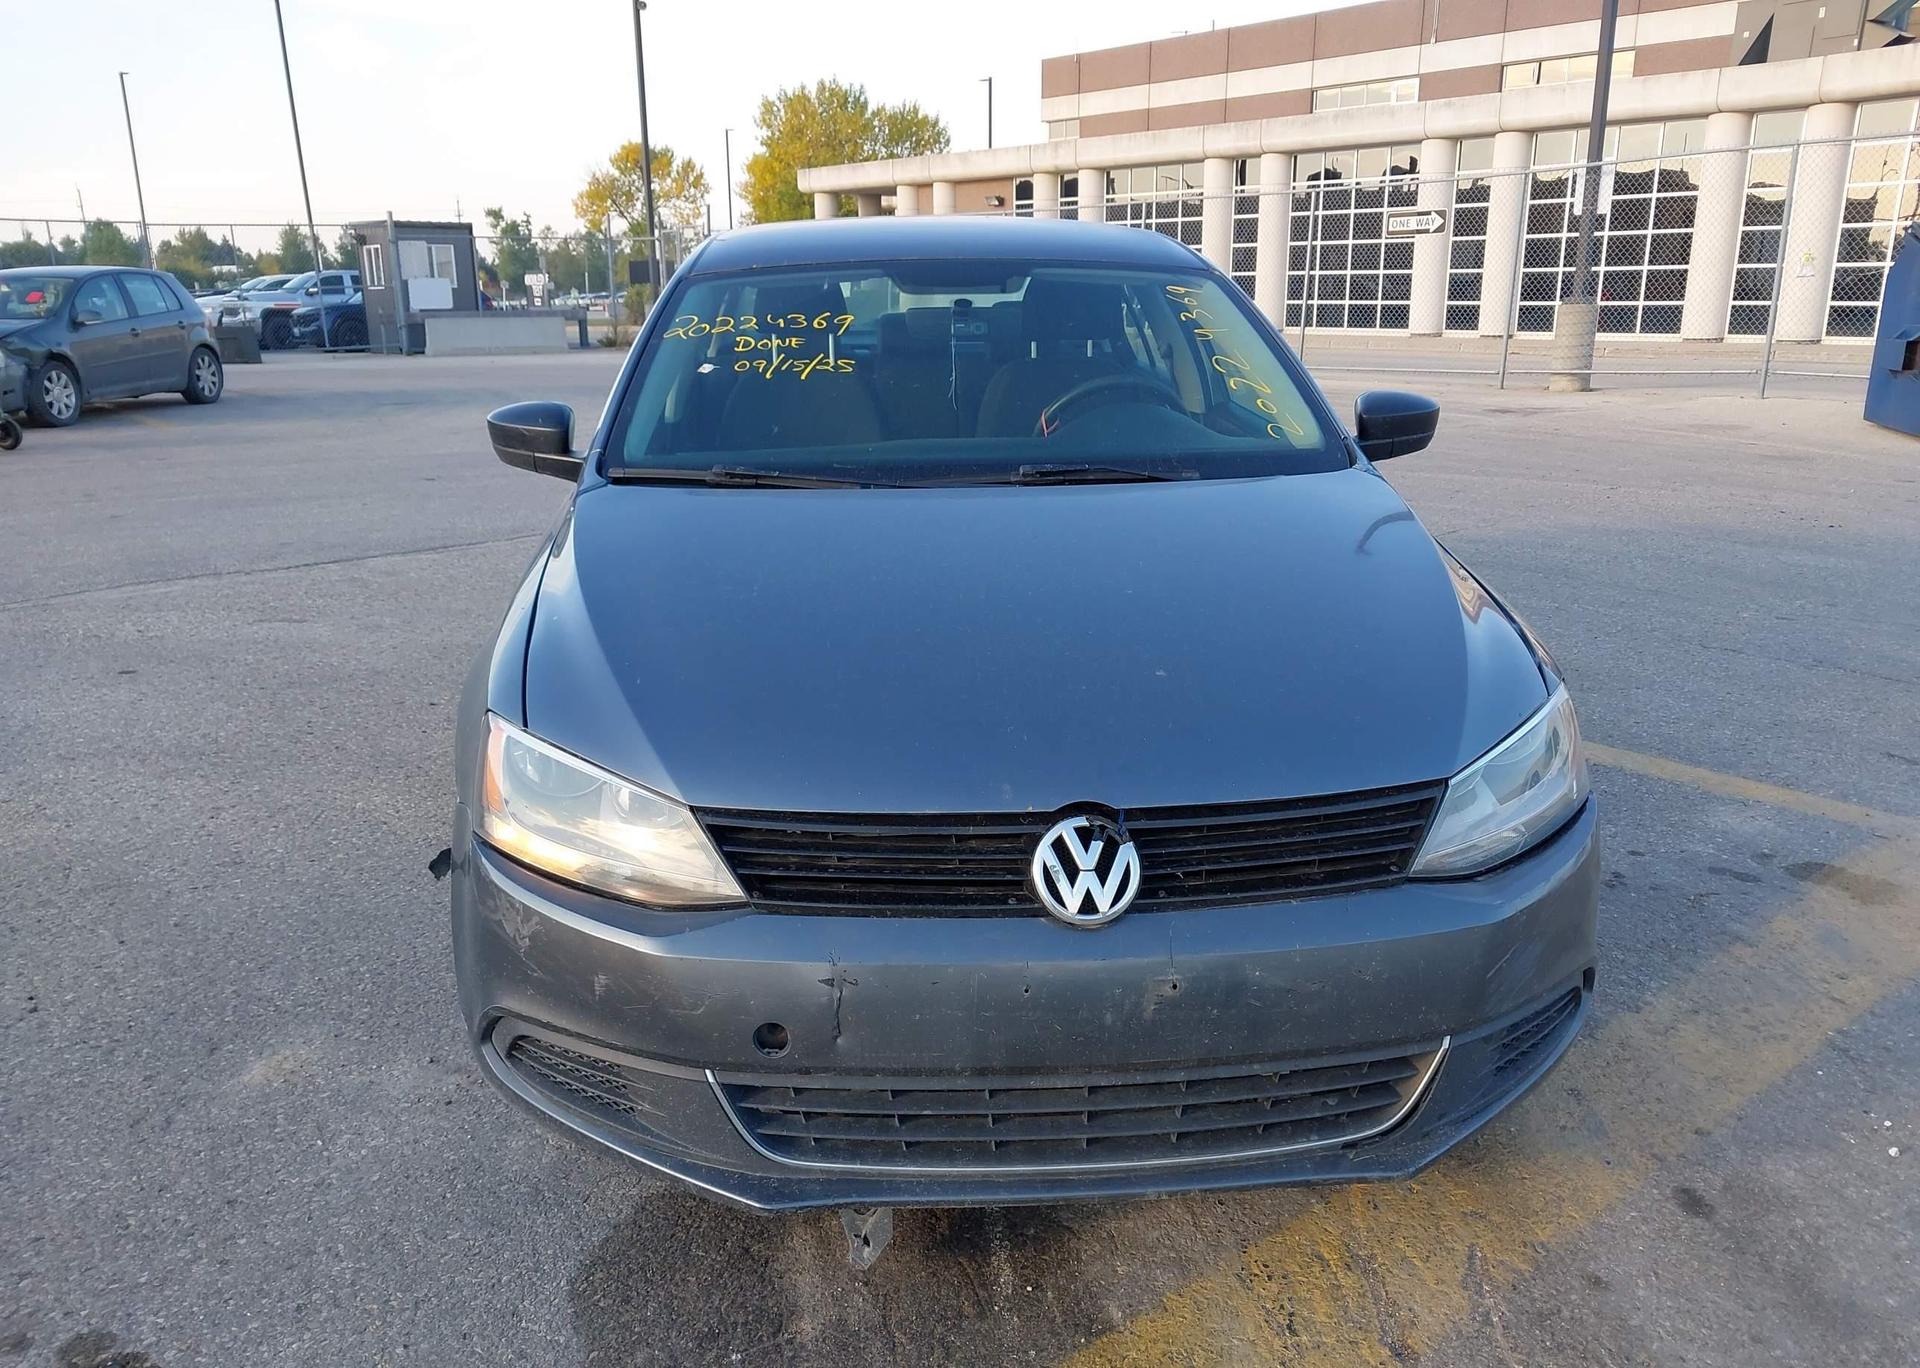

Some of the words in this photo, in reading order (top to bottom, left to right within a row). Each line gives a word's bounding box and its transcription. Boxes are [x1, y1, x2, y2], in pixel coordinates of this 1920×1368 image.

[1391, 218, 1411, 229] ONE
[1415, 216, 1436, 228] WAY
[663, 312, 855, 340] 20224369
[734, 336, 807, 352] DONE
[734, 353, 856, 380] 09/15/25
[1165, 285, 1304, 439] 20224369
[1036, 818, 1139, 921] VW
